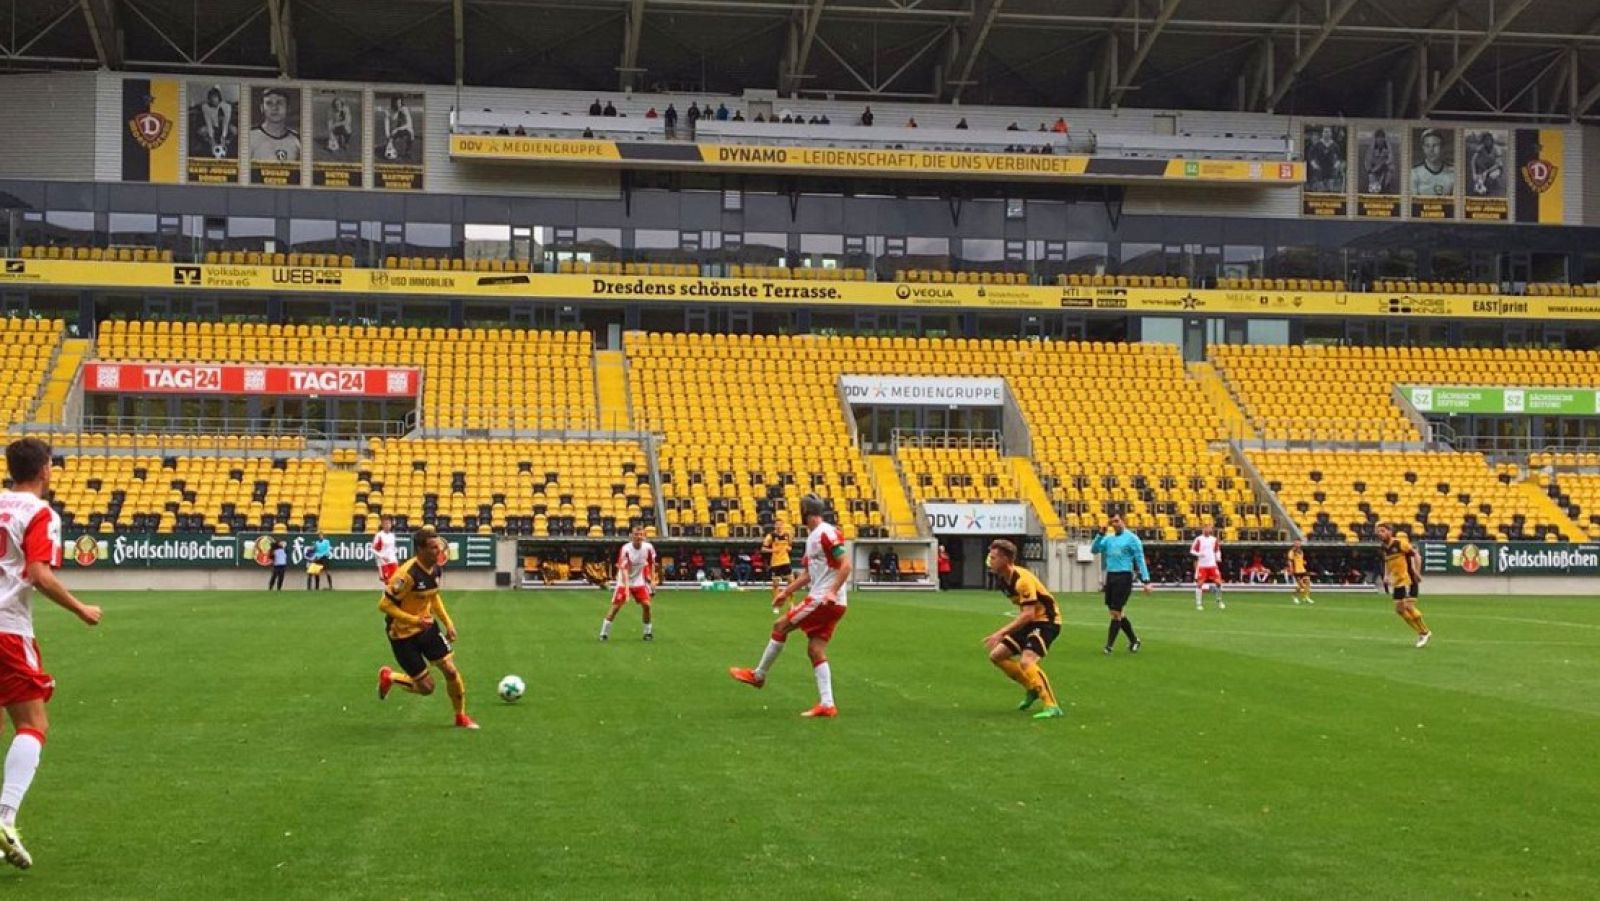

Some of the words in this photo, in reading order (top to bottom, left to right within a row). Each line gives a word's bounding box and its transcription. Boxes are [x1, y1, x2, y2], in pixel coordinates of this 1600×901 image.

[503, 141, 604, 155] MEDIENGRUPPE
[719, 148, 787, 163] DYNAMO
[803, 151, 918, 168] LEIDENSCHAFT,
[922, 155, 946, 168] DIE
[950, 155, 982, 170] UNS
[985, 156, 1072, 172] VERBINDET.
[207, 267, 258, 277] Volksbank
[207, 277, 233, 286] Pirna
[409, 277, 455, 287] IMMOBILIEN
[593, 279, 676, 295] Dresdens
[680, 282, 757, 297] schönste
[763, 283, 842, 299] Terrasse.
[912, 288, 954, 297] VEOLIA
[891, 386, 1000, 399] MEDIENGRUPPE
[113, 535, 233, 565] Feldschlößchen
[1499, 545, 1598, 572] Feldschlößchen
